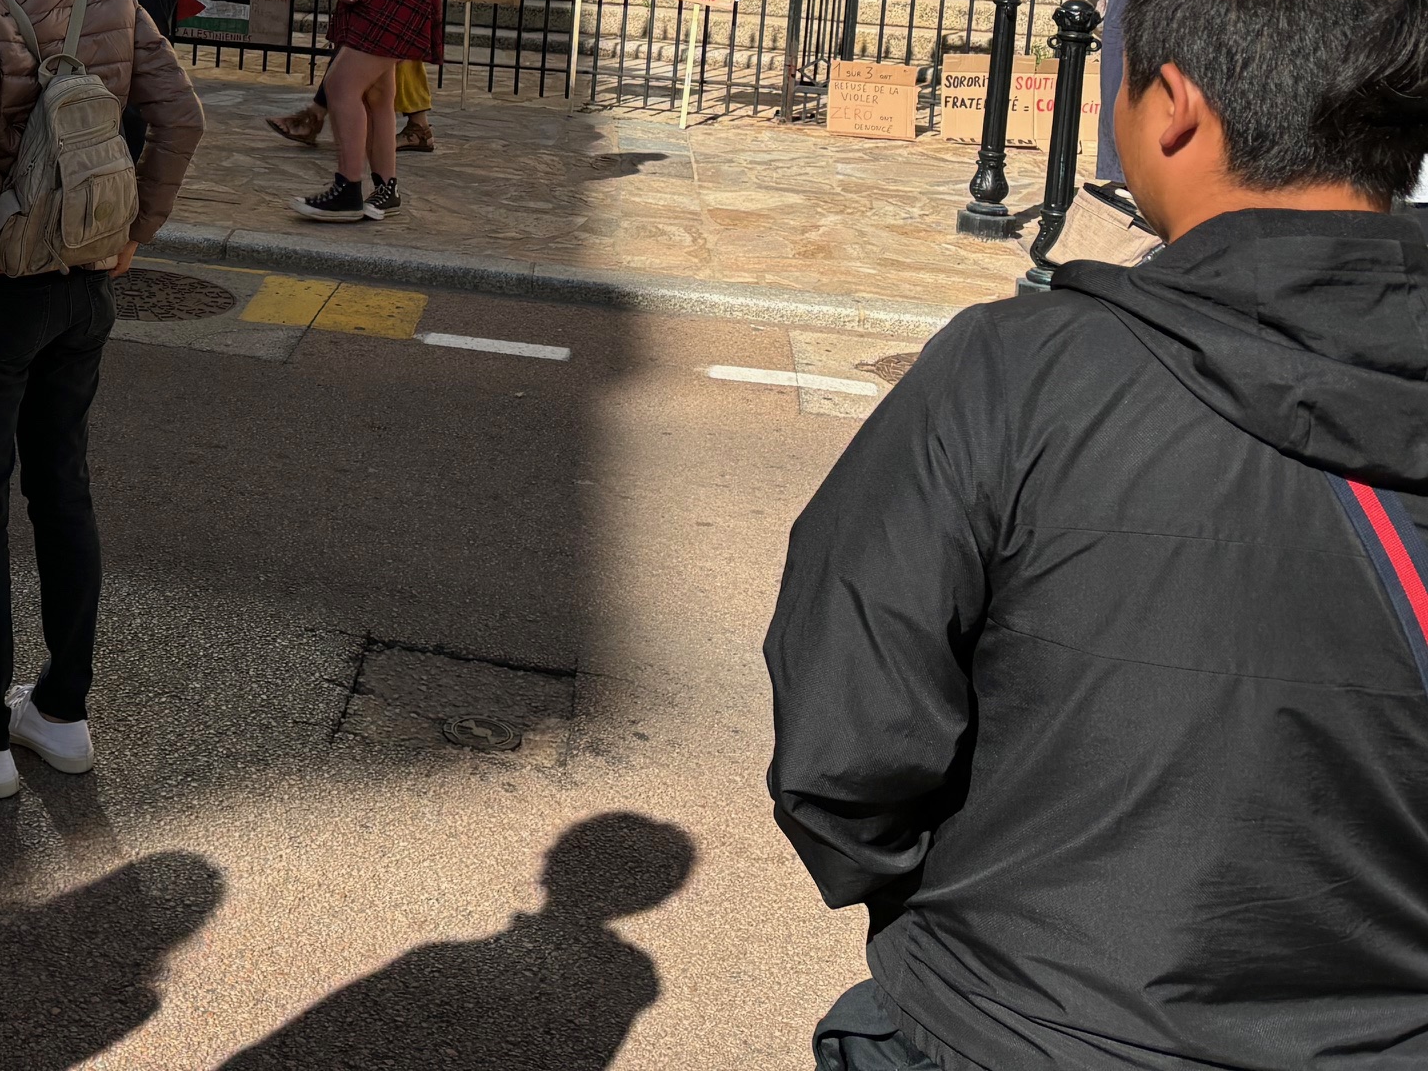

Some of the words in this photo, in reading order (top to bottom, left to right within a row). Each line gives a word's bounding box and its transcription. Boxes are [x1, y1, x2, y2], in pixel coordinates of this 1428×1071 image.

[833, 63, 841, 78] 1
[865, 67, 874, 79] 3
[874, 85, 885, 94] DE
[944, 74, 989, 89] SORORI
[1015, 76, 1055, 91] SOUTI
[841, 92, 879, 104] VIOLER
